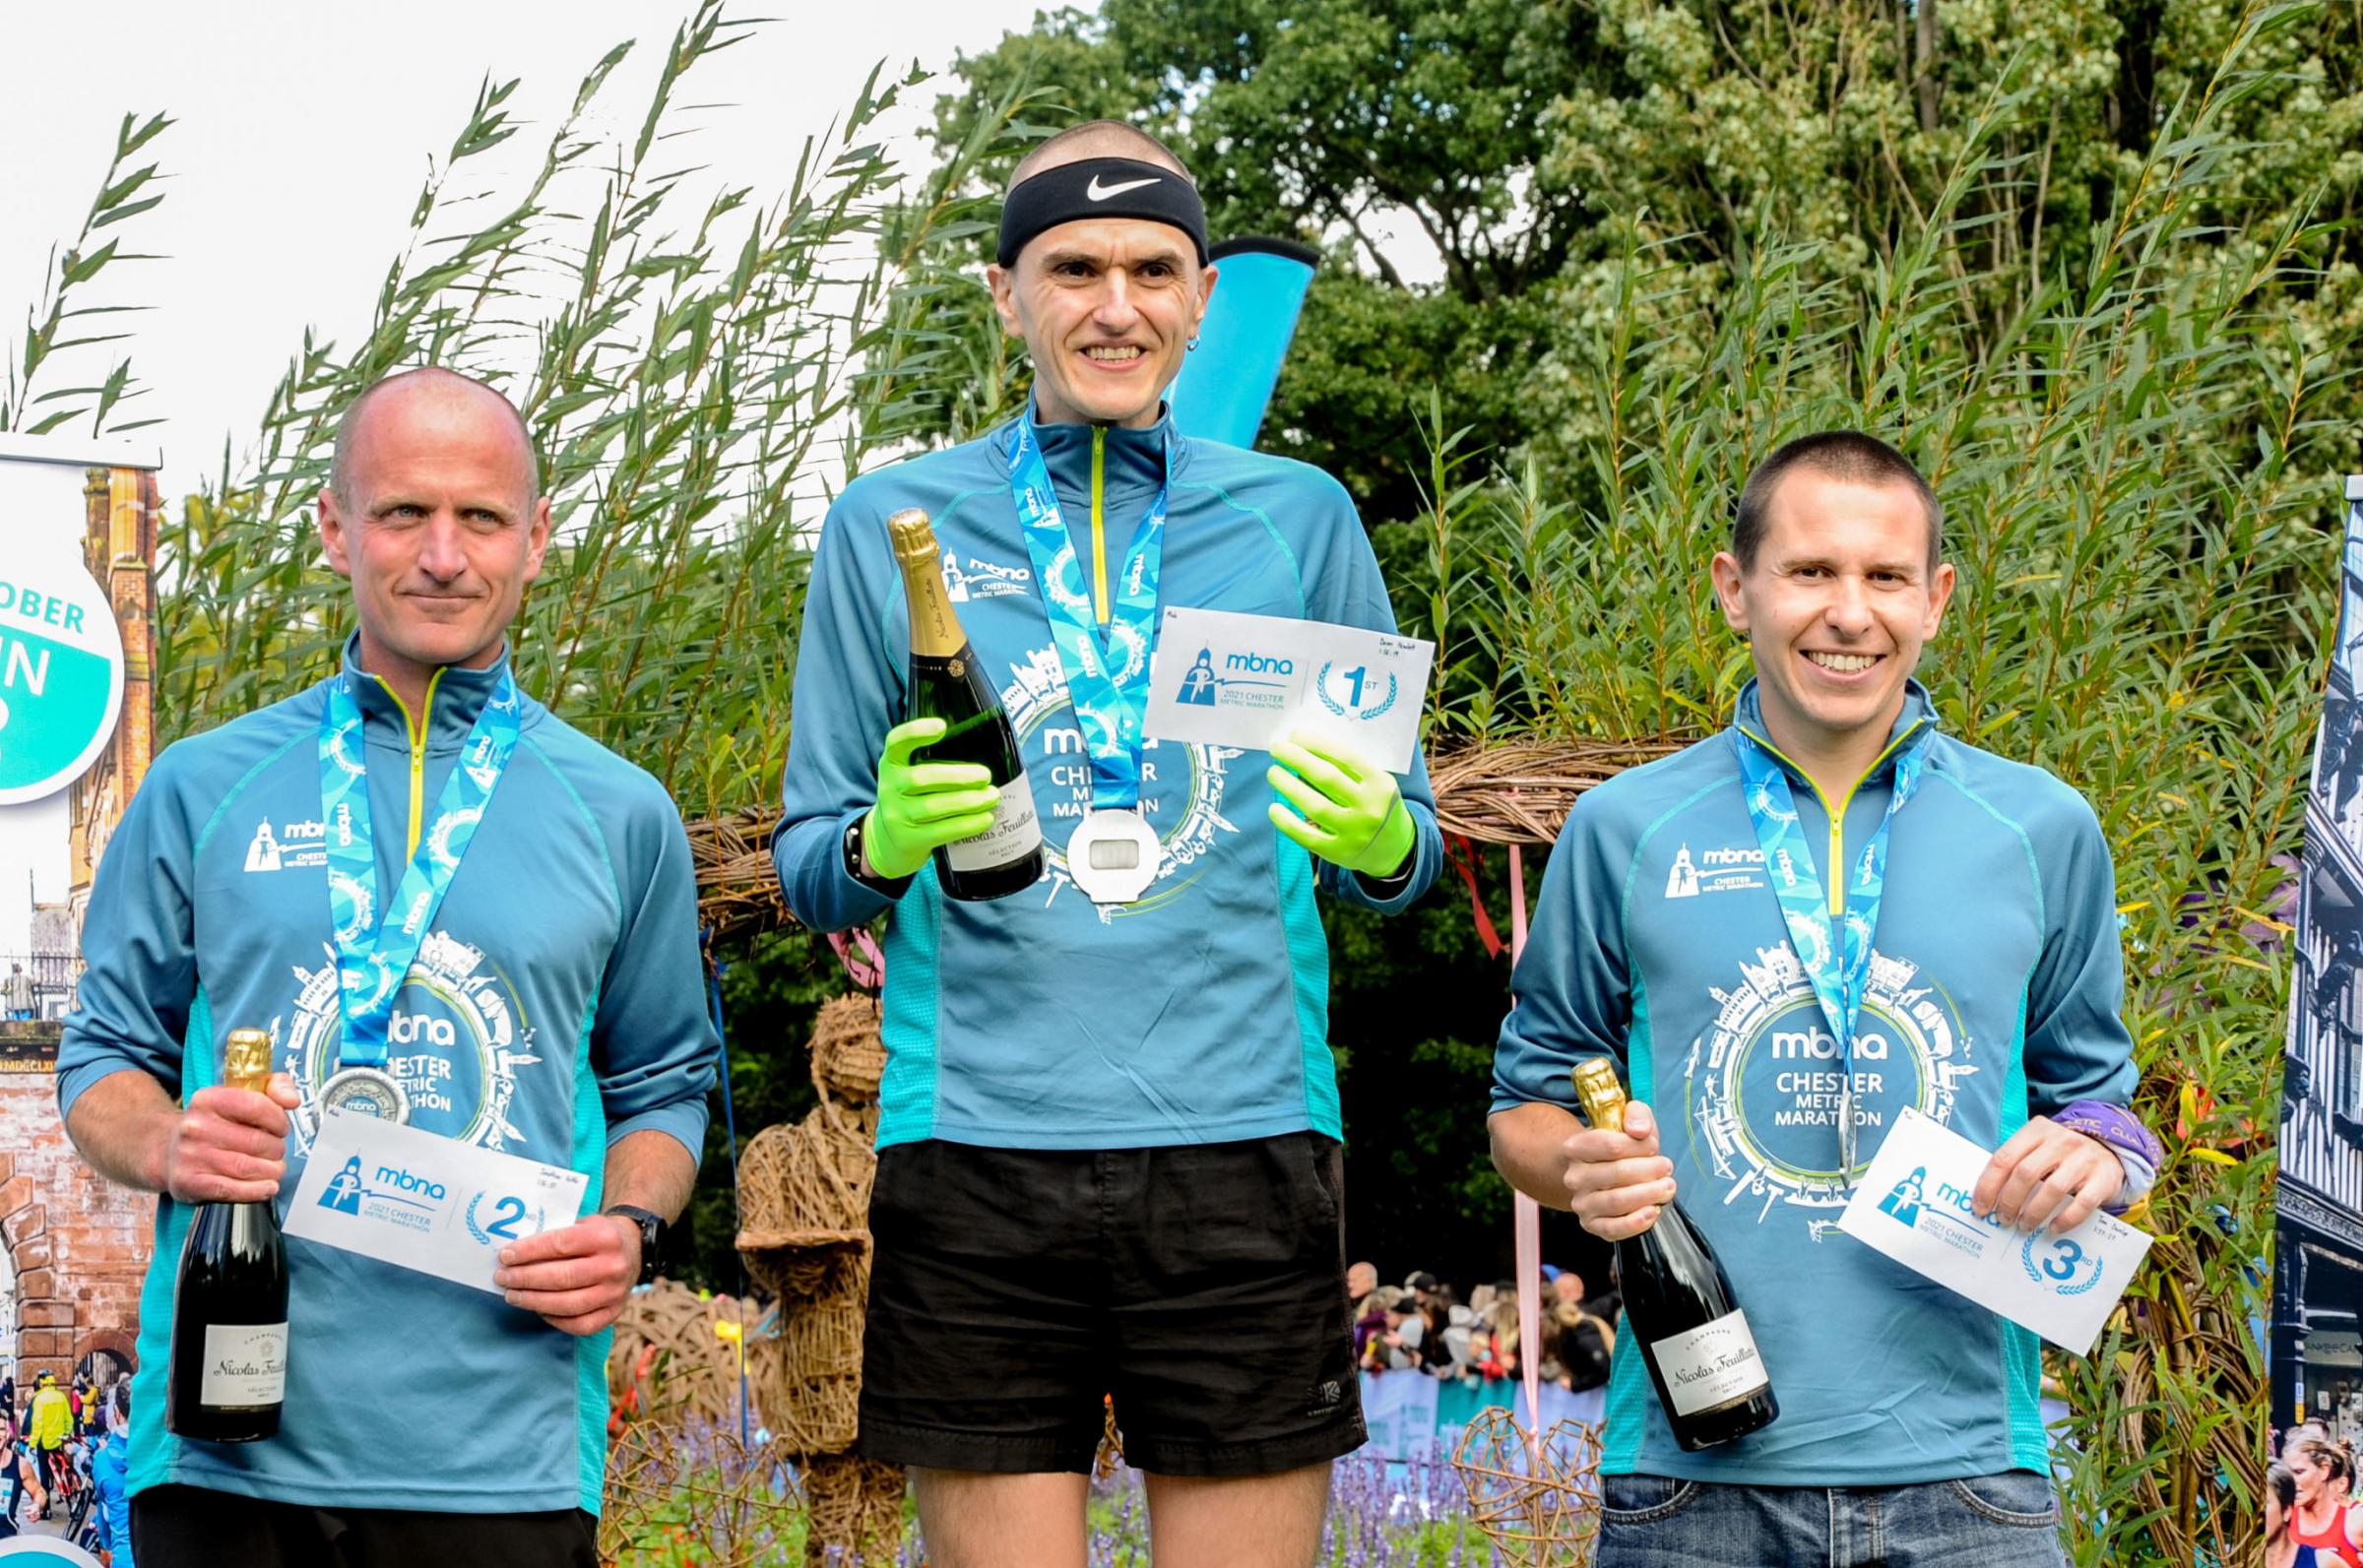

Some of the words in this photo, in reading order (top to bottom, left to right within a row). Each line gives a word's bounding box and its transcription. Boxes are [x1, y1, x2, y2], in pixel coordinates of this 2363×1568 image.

[969, 558, 1030, 581] mbna
[1226, 652, 1293, 675] mbna
[1224, 690, 1244, 699] 2021
[1245, 692, 1285, 703] CHESTER
[337, 803, 352, 847] mbna
[1703, 847, 1765, 864] mbna
[388, 1010, 455, 1045] bna
[1775, 1110, 1882, 1126] MARATON
[375, 1166, 445, 1200] mbna
[368, 1203, 391, 1215] 2021
[390, 1209, 431, 1226] CHESTER
[1945, 1228, 1985, 1252] CHESTER
[213, 1359, 260, 1376] Nicolas
[1674, 1364, 1714, 1388] Nicolas
